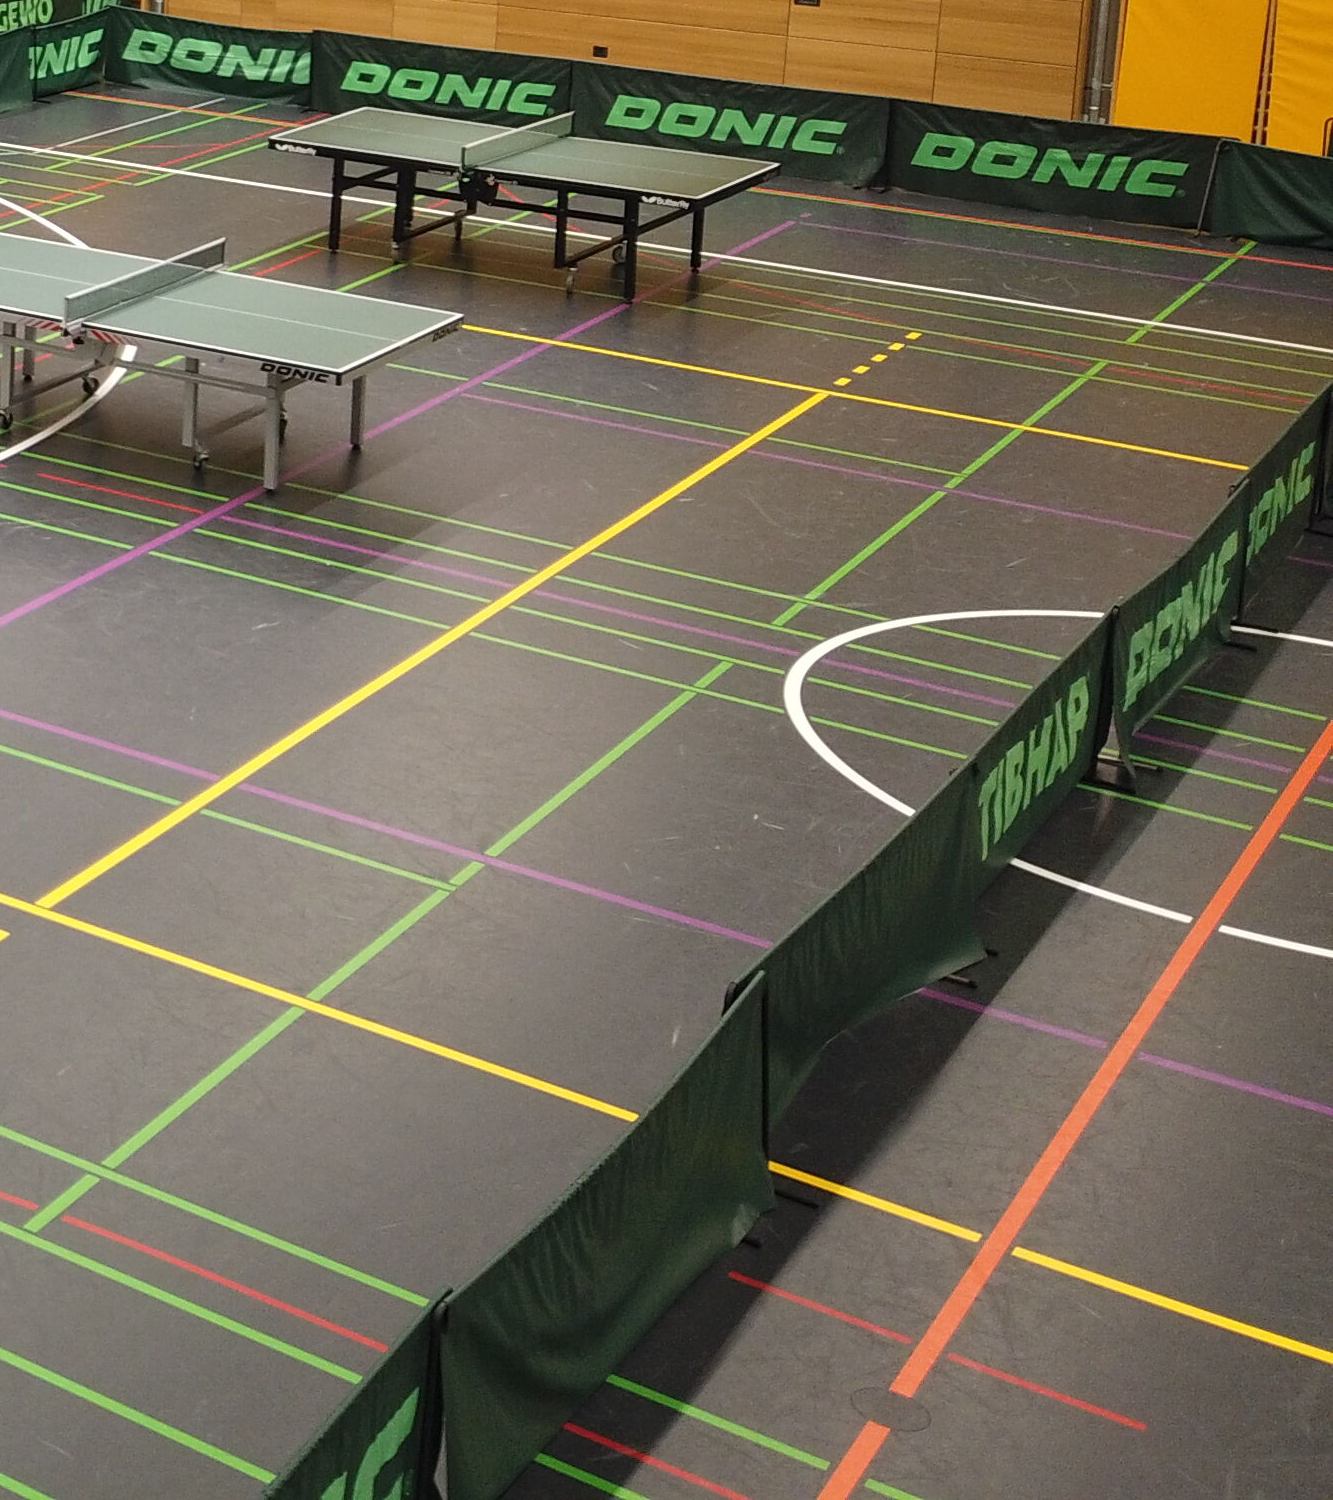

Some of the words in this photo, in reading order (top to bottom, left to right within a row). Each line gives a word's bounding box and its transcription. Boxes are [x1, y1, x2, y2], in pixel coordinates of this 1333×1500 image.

[340, 61, 556, 115] DONIC
[605, 95, 847, 155] DONIC
[911, 133, 1189, 197] DONIC
[260, 362, 330, 383] DONIC
[1123, 531, 1238, 712] DONIC
[978, 675, 1090, 861] TIBHAR
